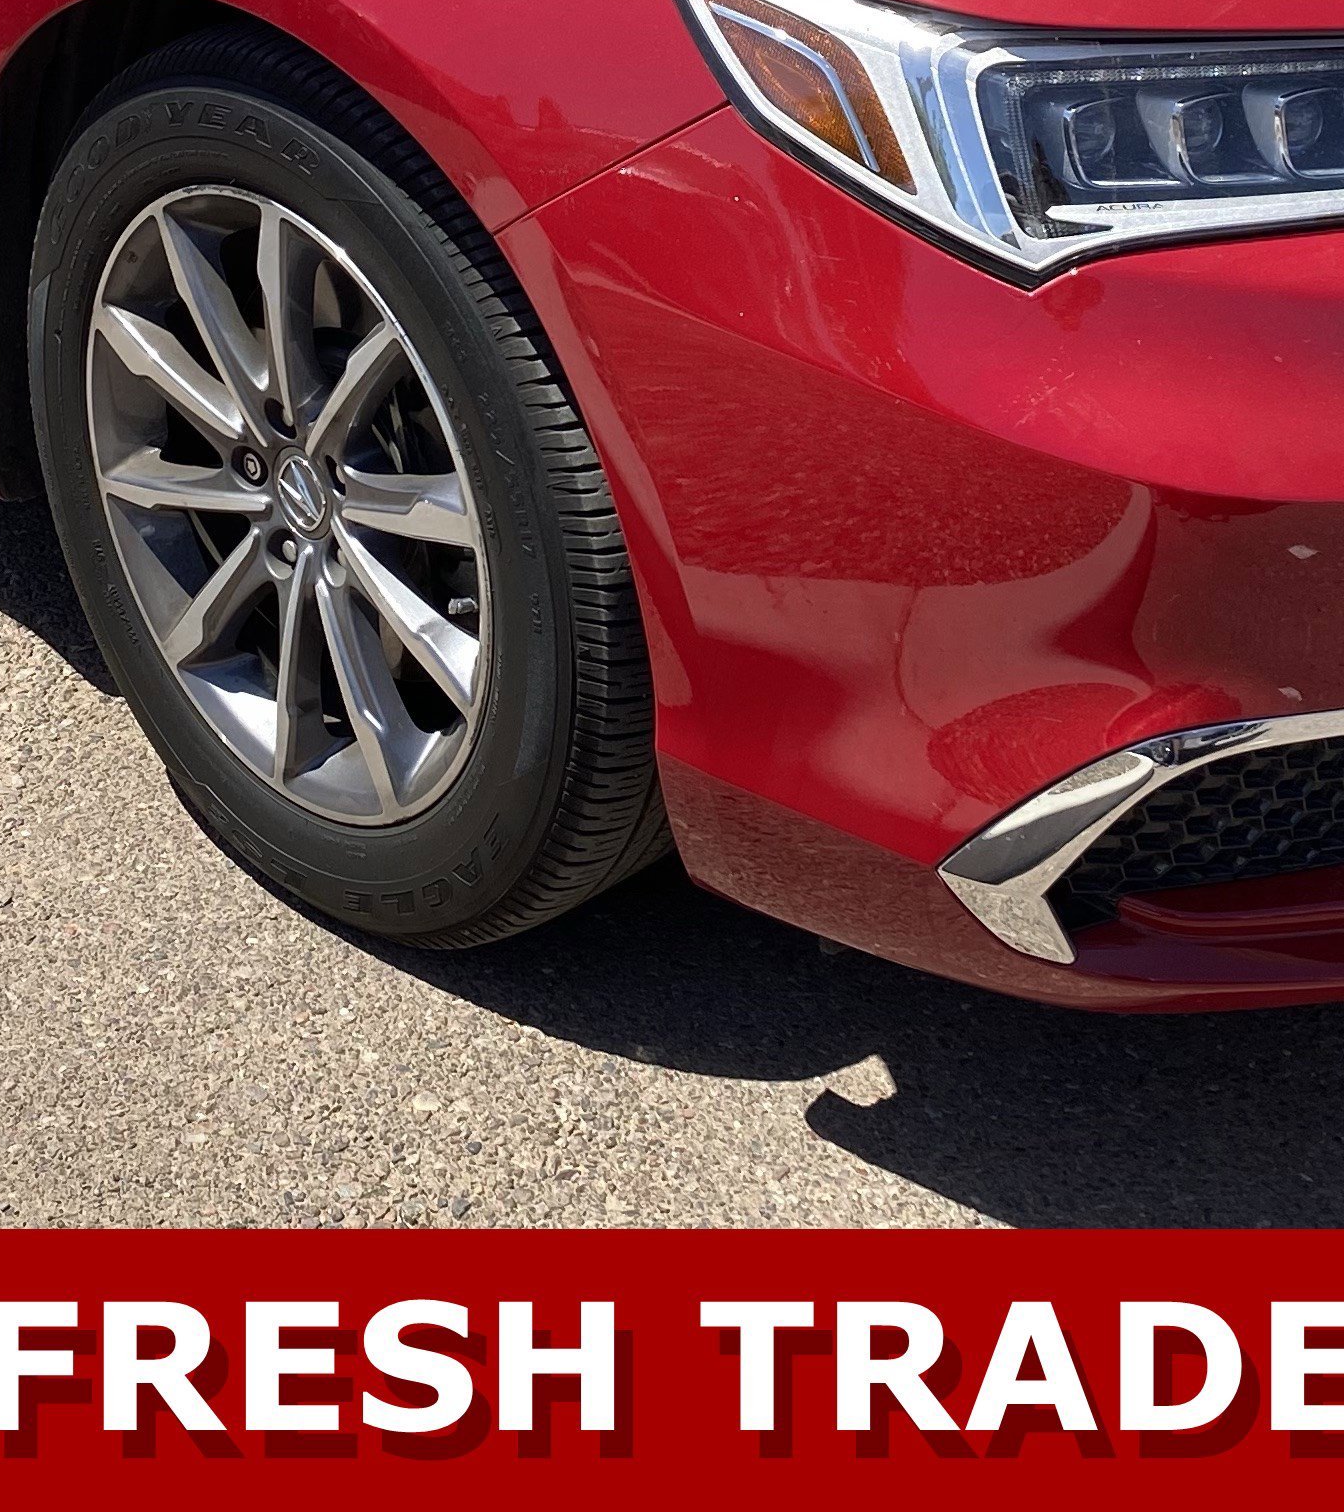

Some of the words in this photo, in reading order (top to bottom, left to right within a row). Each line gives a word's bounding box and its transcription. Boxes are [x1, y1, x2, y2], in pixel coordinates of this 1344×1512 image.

[50, 101, 322, 245] GOODYEAR
[1095, 203, 1164, 212] ACURA
[340, 811, 511, 917] EAGLE
